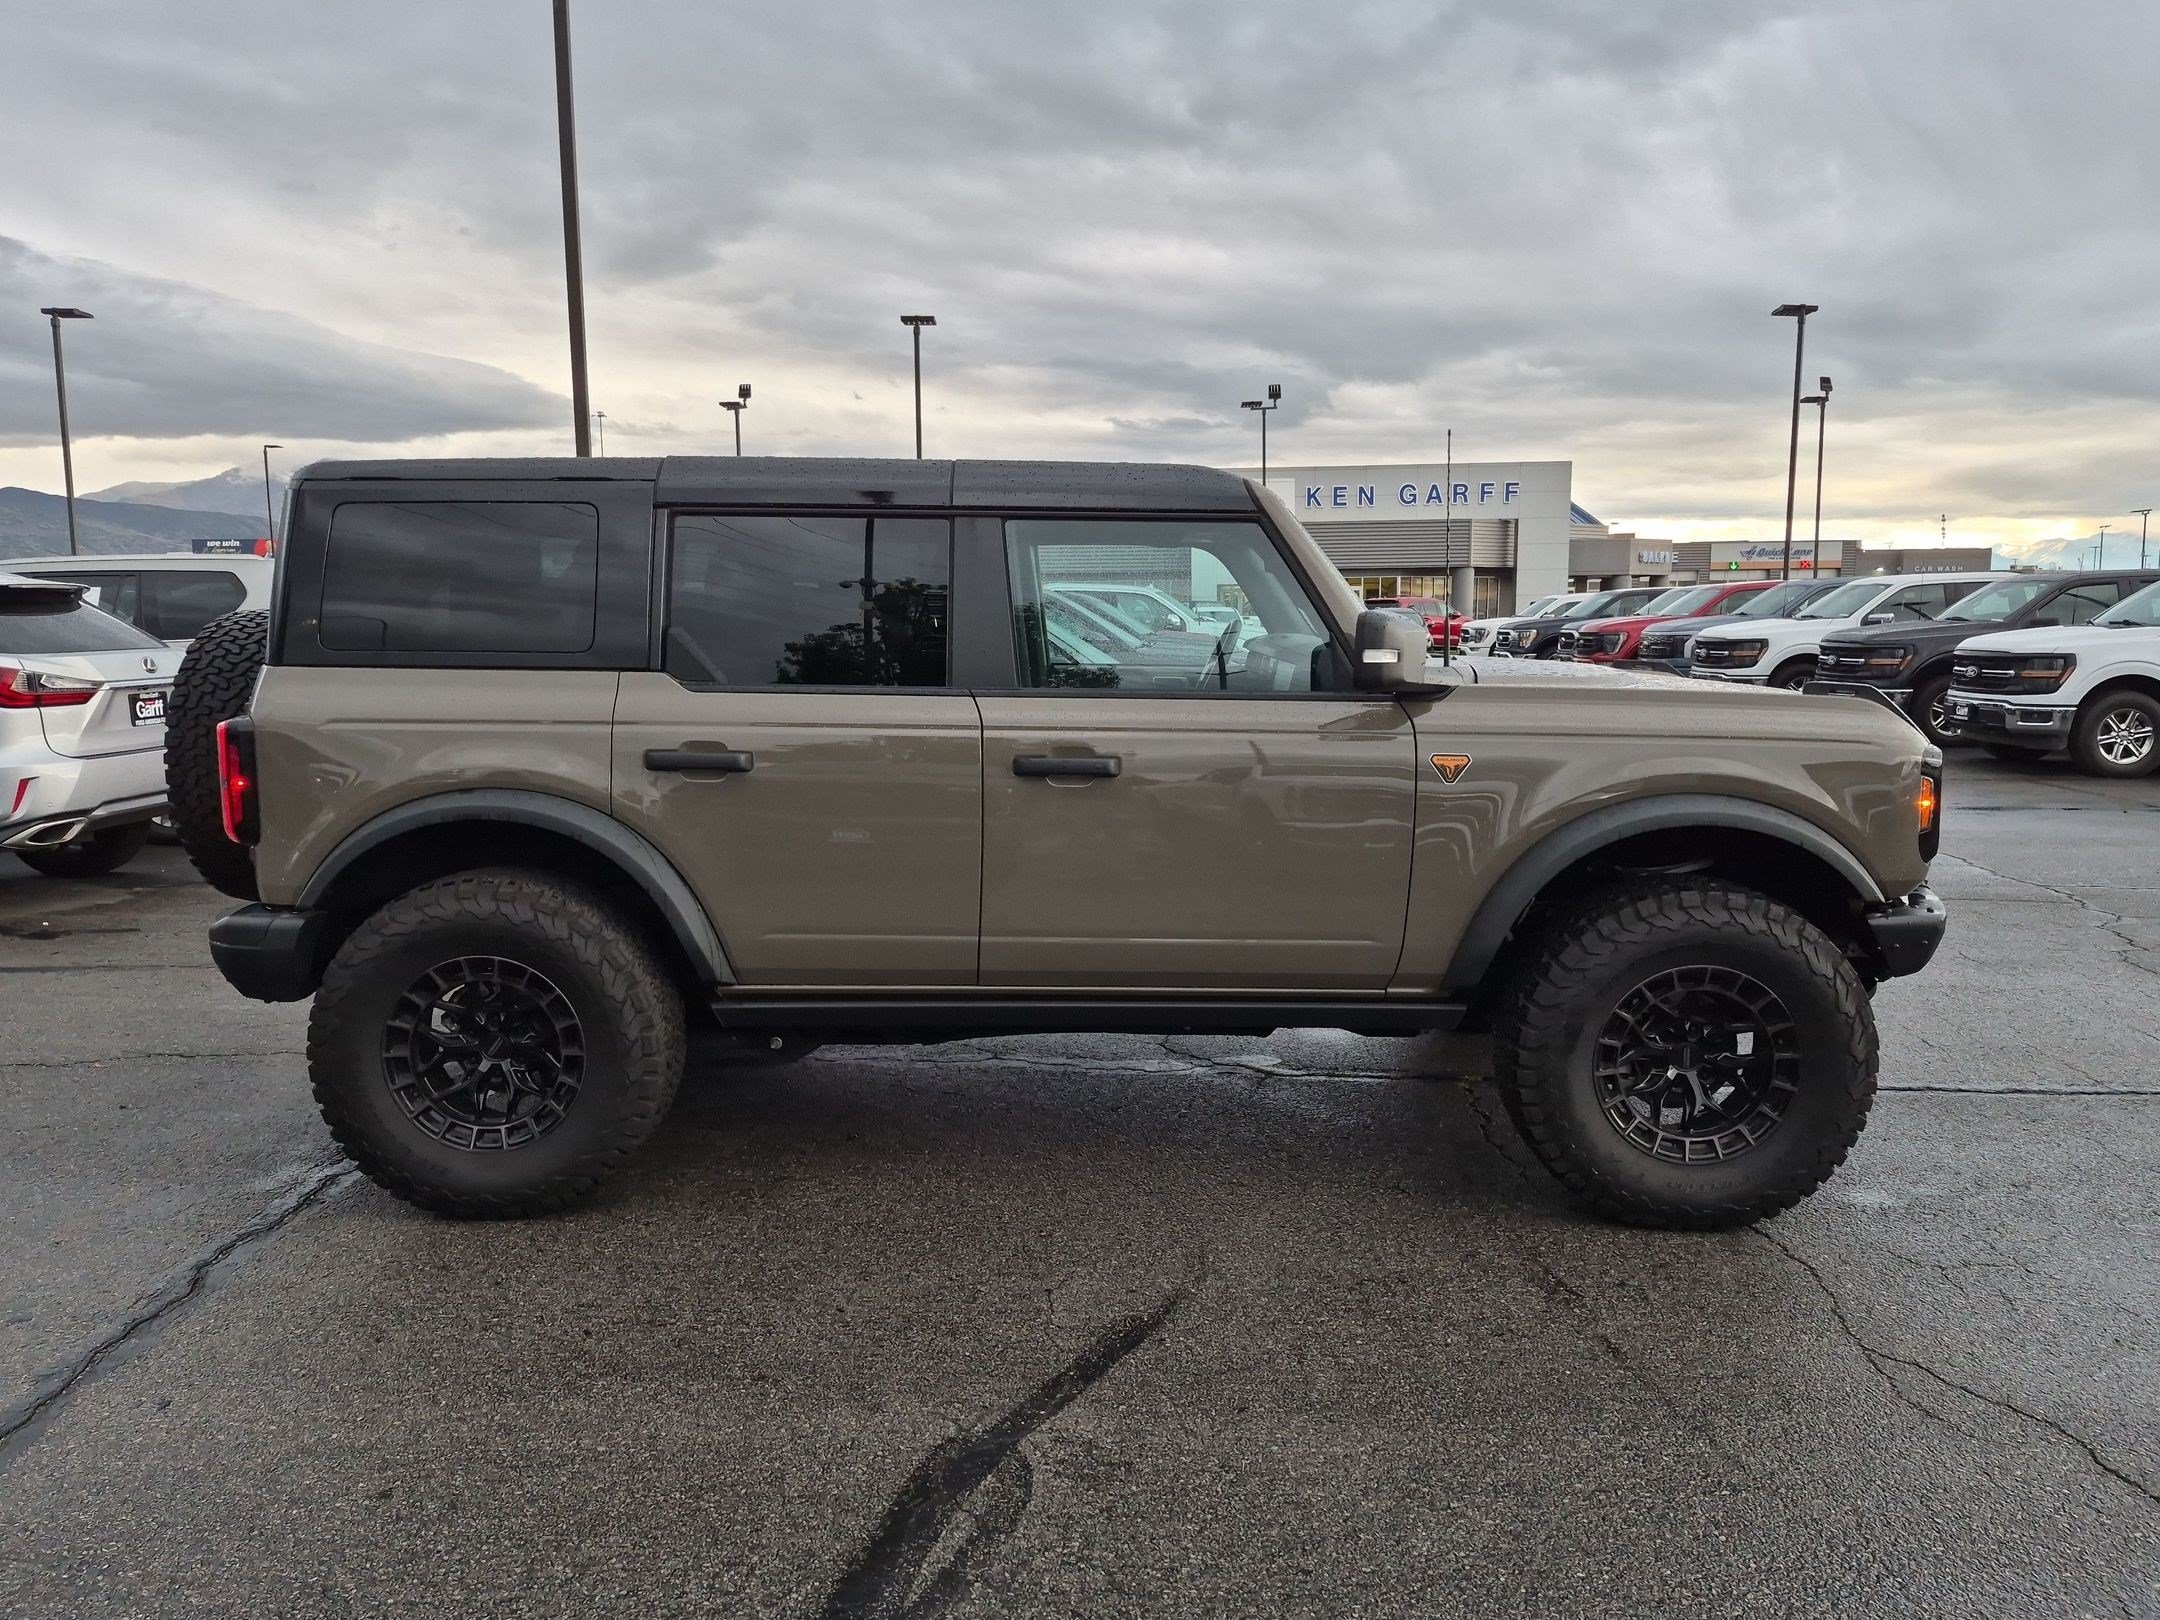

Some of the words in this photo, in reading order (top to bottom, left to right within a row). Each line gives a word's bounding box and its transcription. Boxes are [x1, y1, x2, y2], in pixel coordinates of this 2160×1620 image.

[1305, 484, 1376, 508] KEN
[1398, 481, 1521, 507] GARFF
[222, 539, 240, 547] win
[136, 699, 164, 718] Garff
